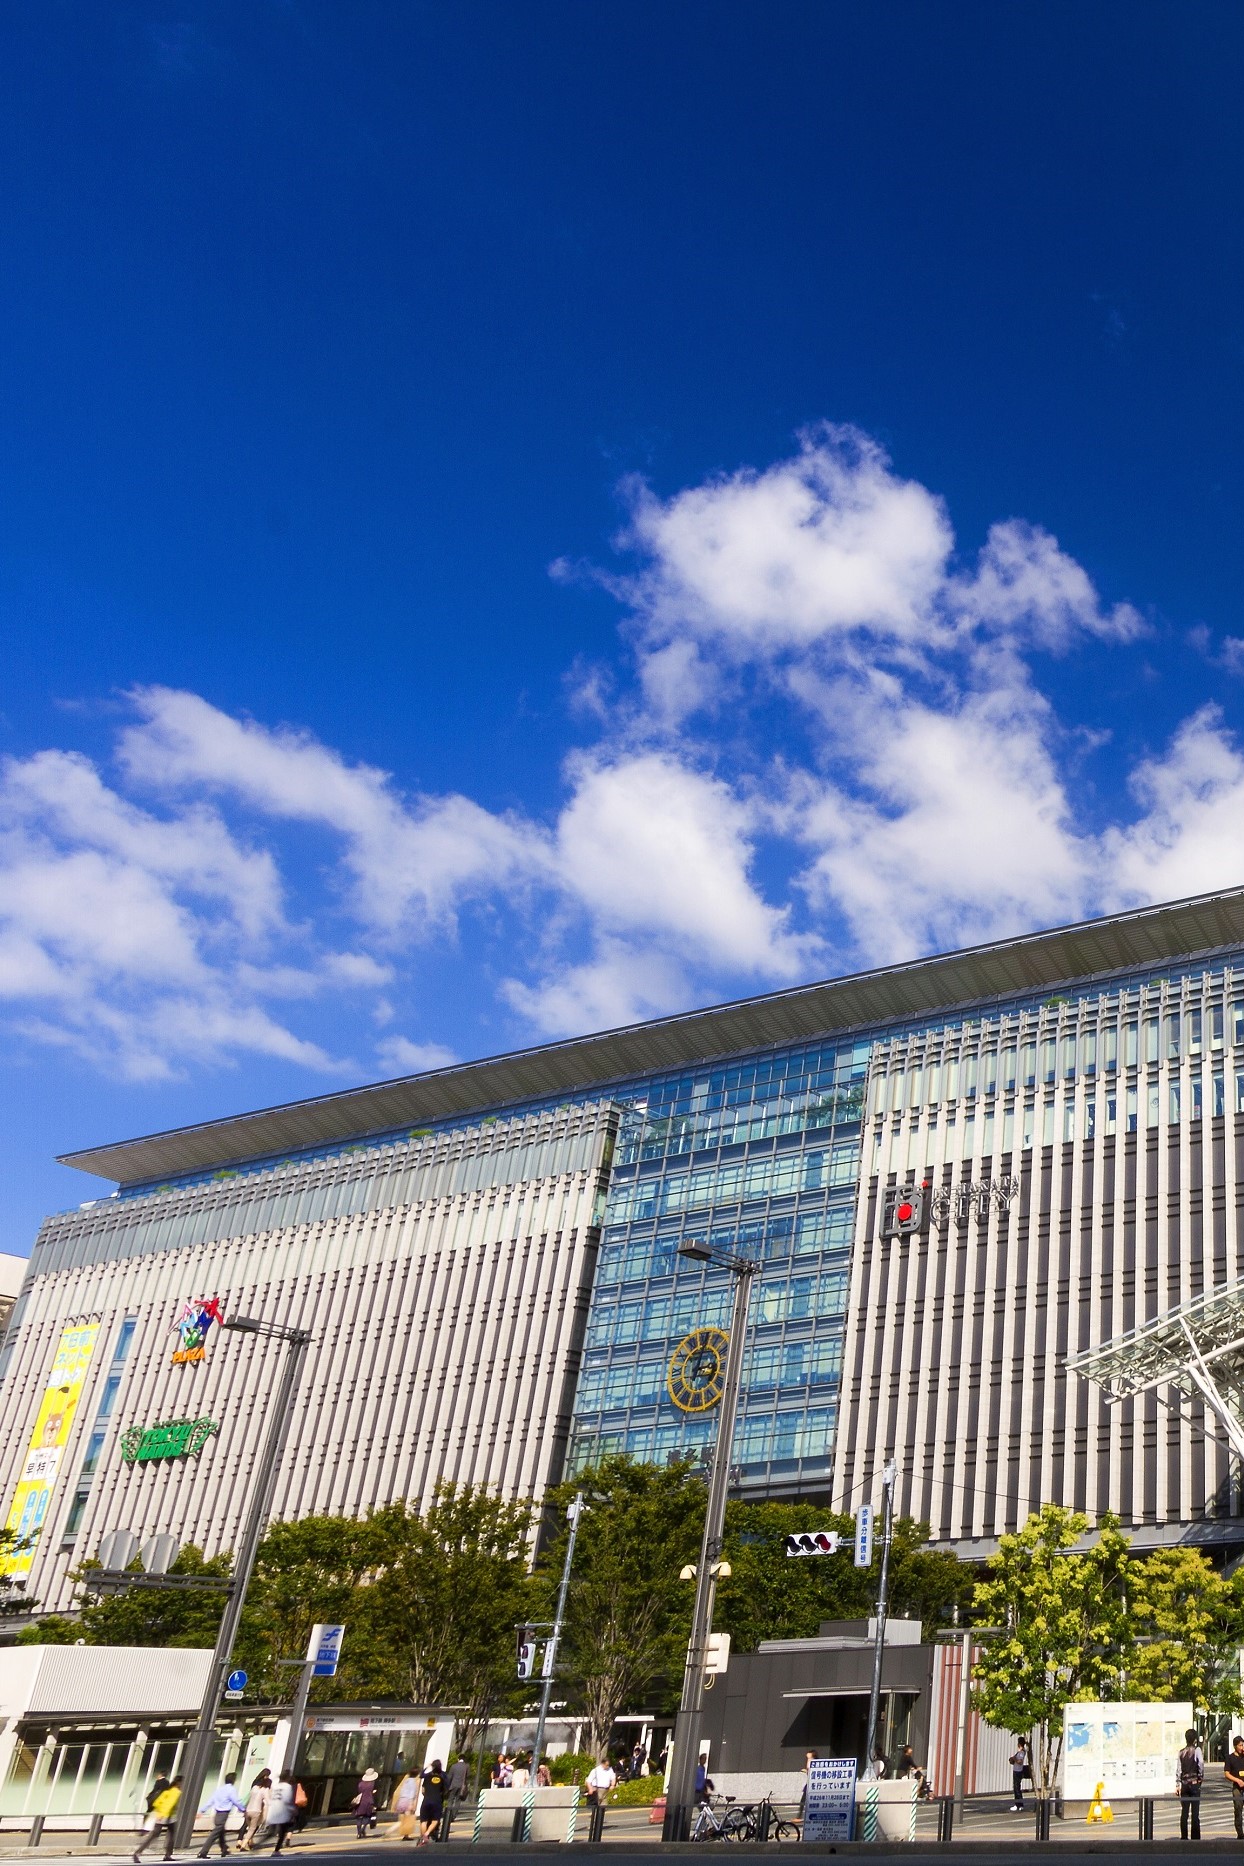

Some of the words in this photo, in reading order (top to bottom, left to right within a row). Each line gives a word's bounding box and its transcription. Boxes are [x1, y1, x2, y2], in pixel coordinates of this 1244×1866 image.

[172, 1346, 206, 1364] PLAZA
[144, 1425, 193, 1445] TOKYU
[137, 1441, 184, 1460] HANDS
[811, 1781, 851, 1790] を行っています
